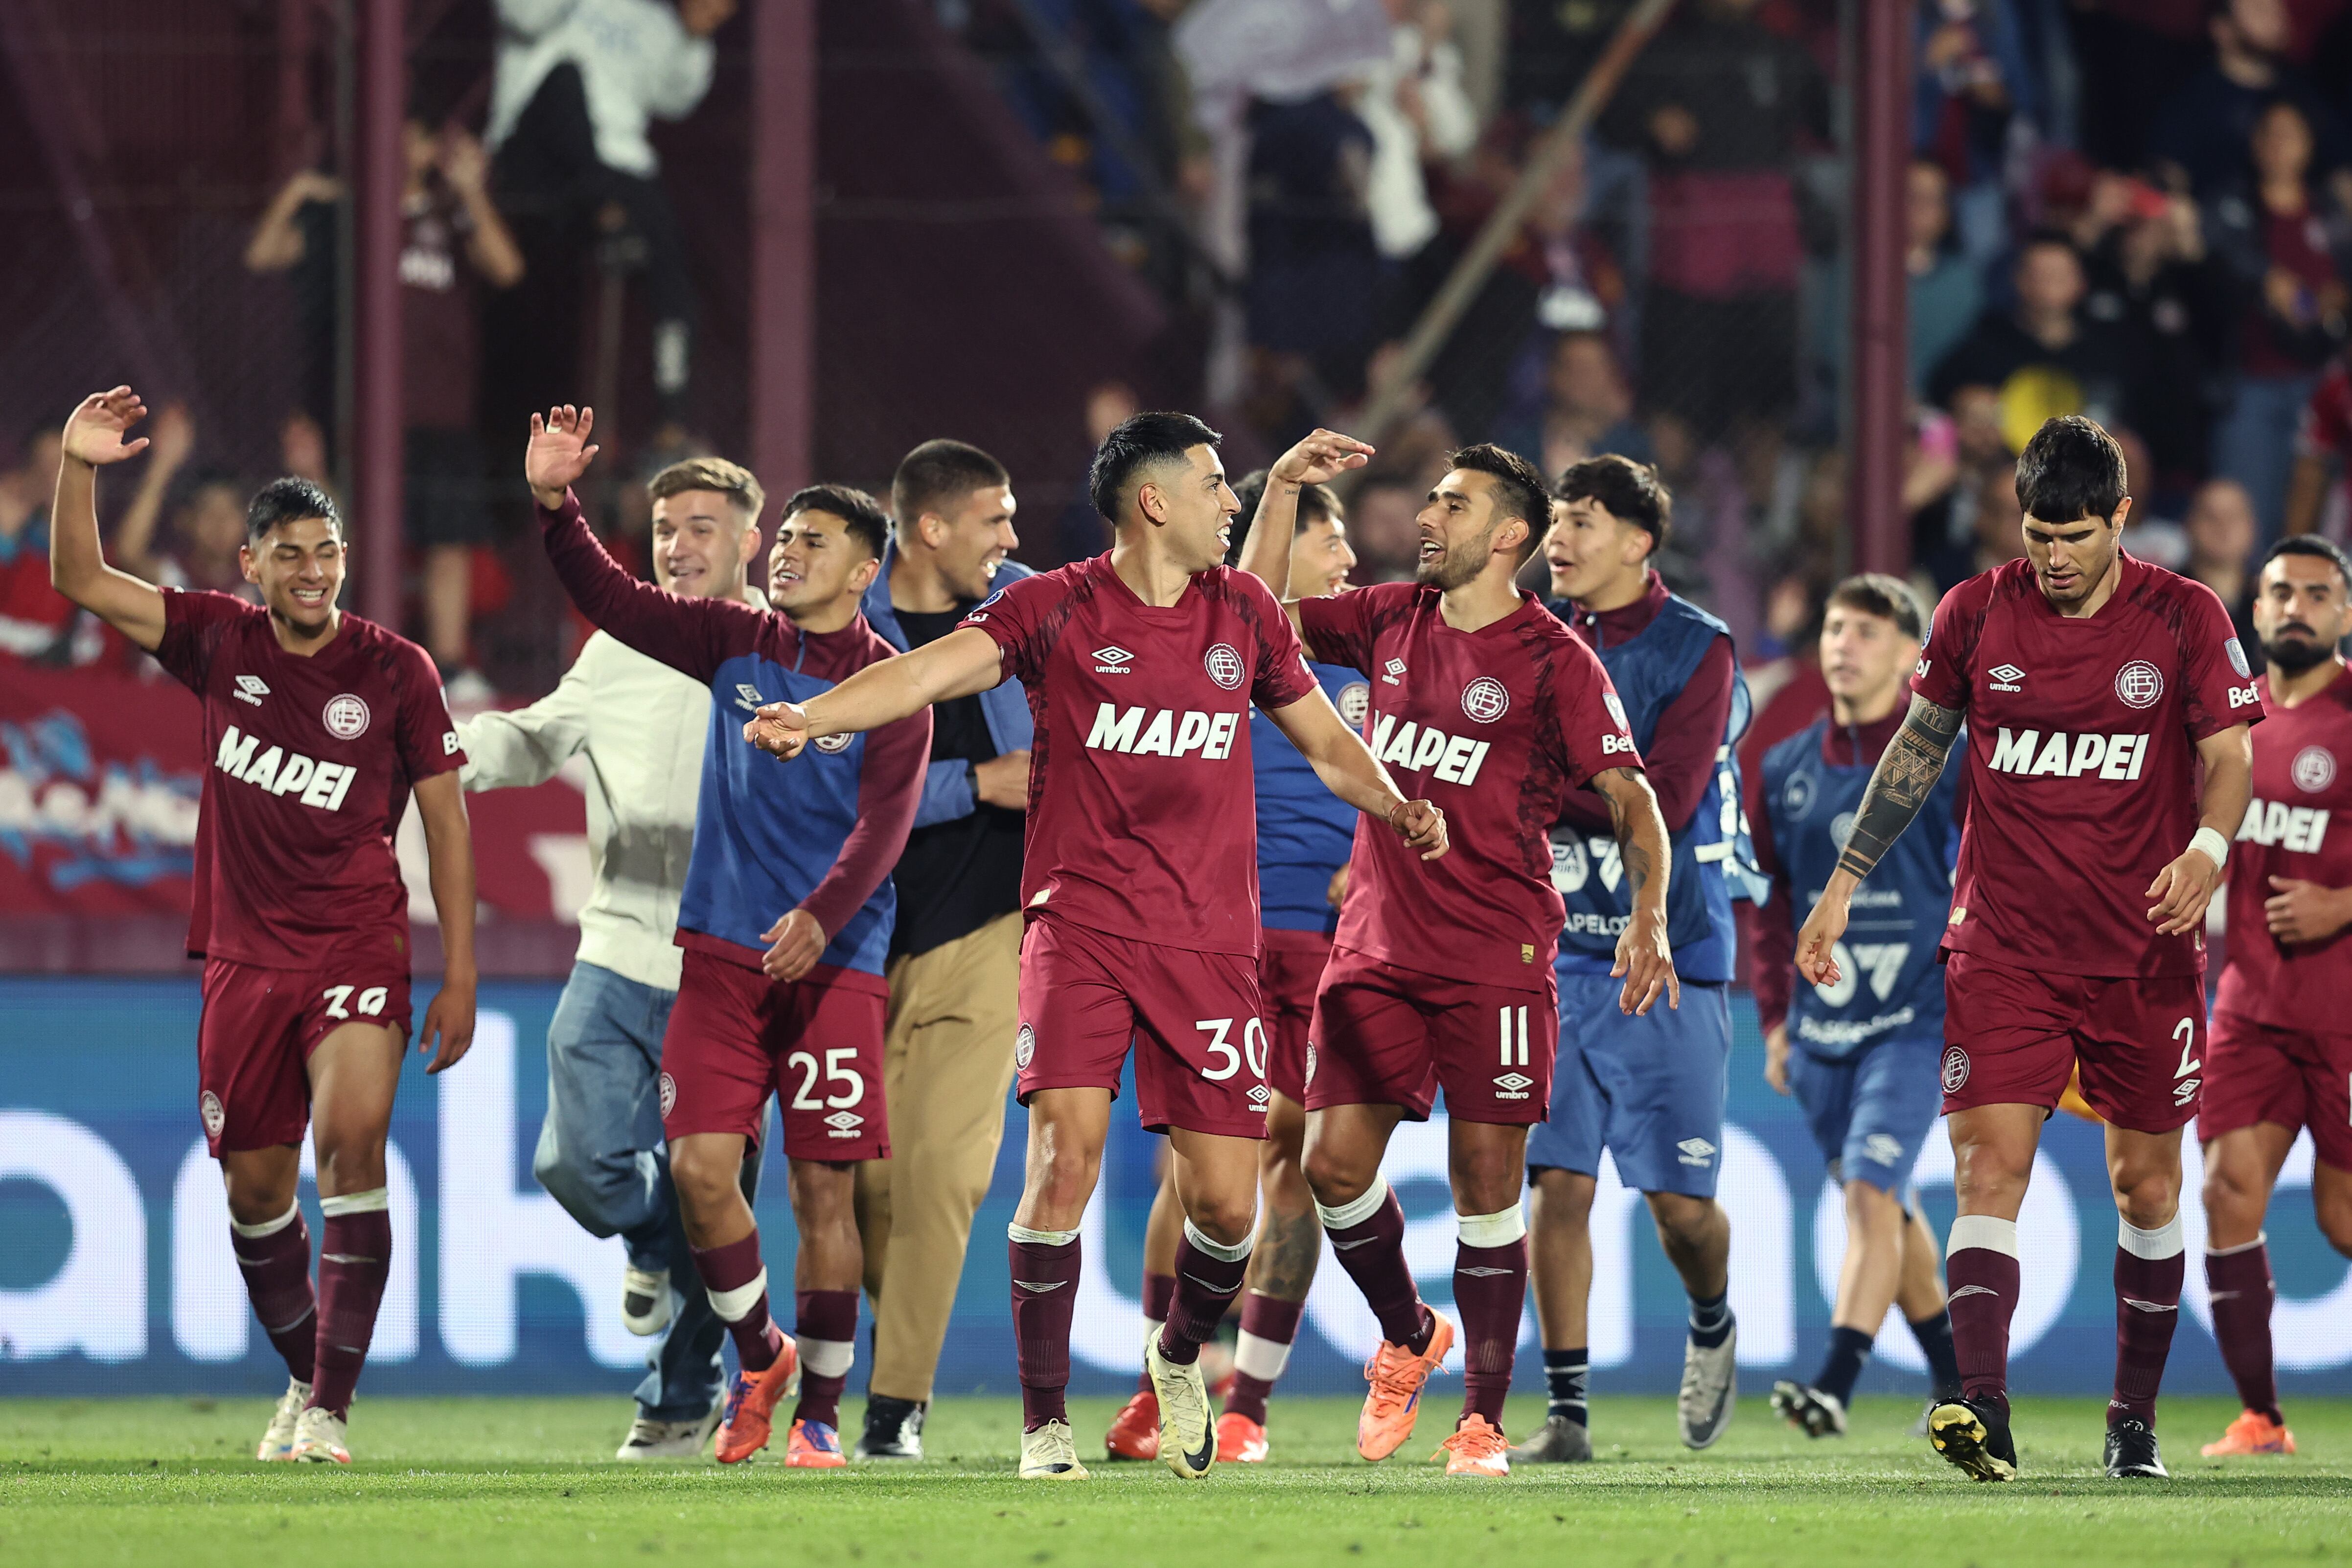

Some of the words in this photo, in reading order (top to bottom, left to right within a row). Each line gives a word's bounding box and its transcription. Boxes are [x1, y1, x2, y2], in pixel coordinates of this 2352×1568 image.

[1095, 665, 1130, 674] umbro
[1382, 673, 1400, 686] umbro
[1989, 682, 2021, 692] umbro
[1085, 702, 1240, 760] MAPEI
[1987, 727, 2150, 780] MAPEI
[215, 724, 357, 811] MAPEI
[2235, 797, 2331, 854] APEI
[1196, 1017, 1268, 1081] 30
[1500, 1005, 1528, 1066] 11
[2172, 1017, 2201, 1080] 2
[788, 1047, 864, 1110] 25
[1496, 1089, 1529, 1100] umbro
[828, 1129, 862, 1138] umbro
[1248, 1103, 1268, 1112] umbr
